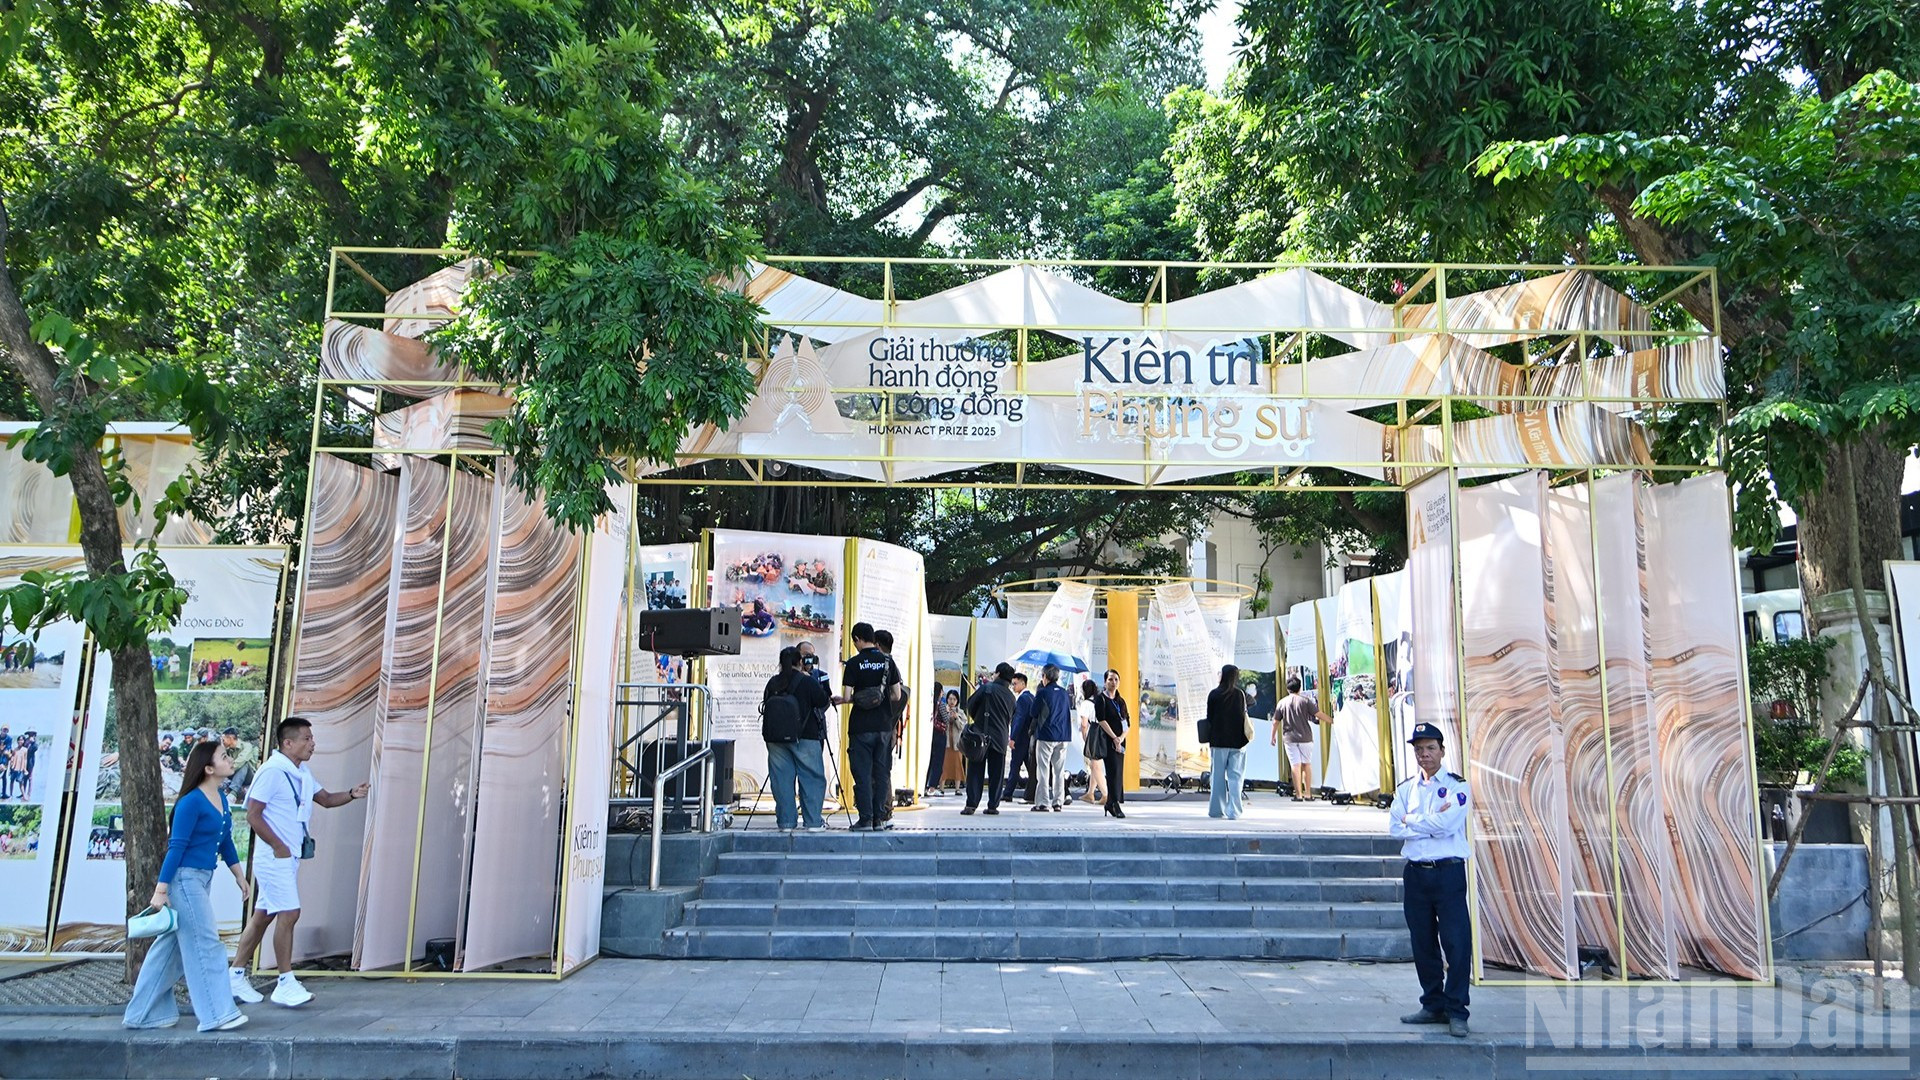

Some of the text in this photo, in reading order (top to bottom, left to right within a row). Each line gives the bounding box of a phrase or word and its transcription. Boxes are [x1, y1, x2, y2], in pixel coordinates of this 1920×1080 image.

[869, 336, 914, 361] Giải
[1083, 336, 1259, 386] Kiên trì
[869, 363, 997, 394] hành động
[869, 390, 1023, 422] vì công đồng
[868, 426, 996, 436] HUMAN ACT PRIZE 2025
[1081, 390, 1313, 451] Phụng sự
[717, 671, 731, 679] One
[753, 671, 772, 679] Vietn
[859, 662, 886, 670] kingpr
